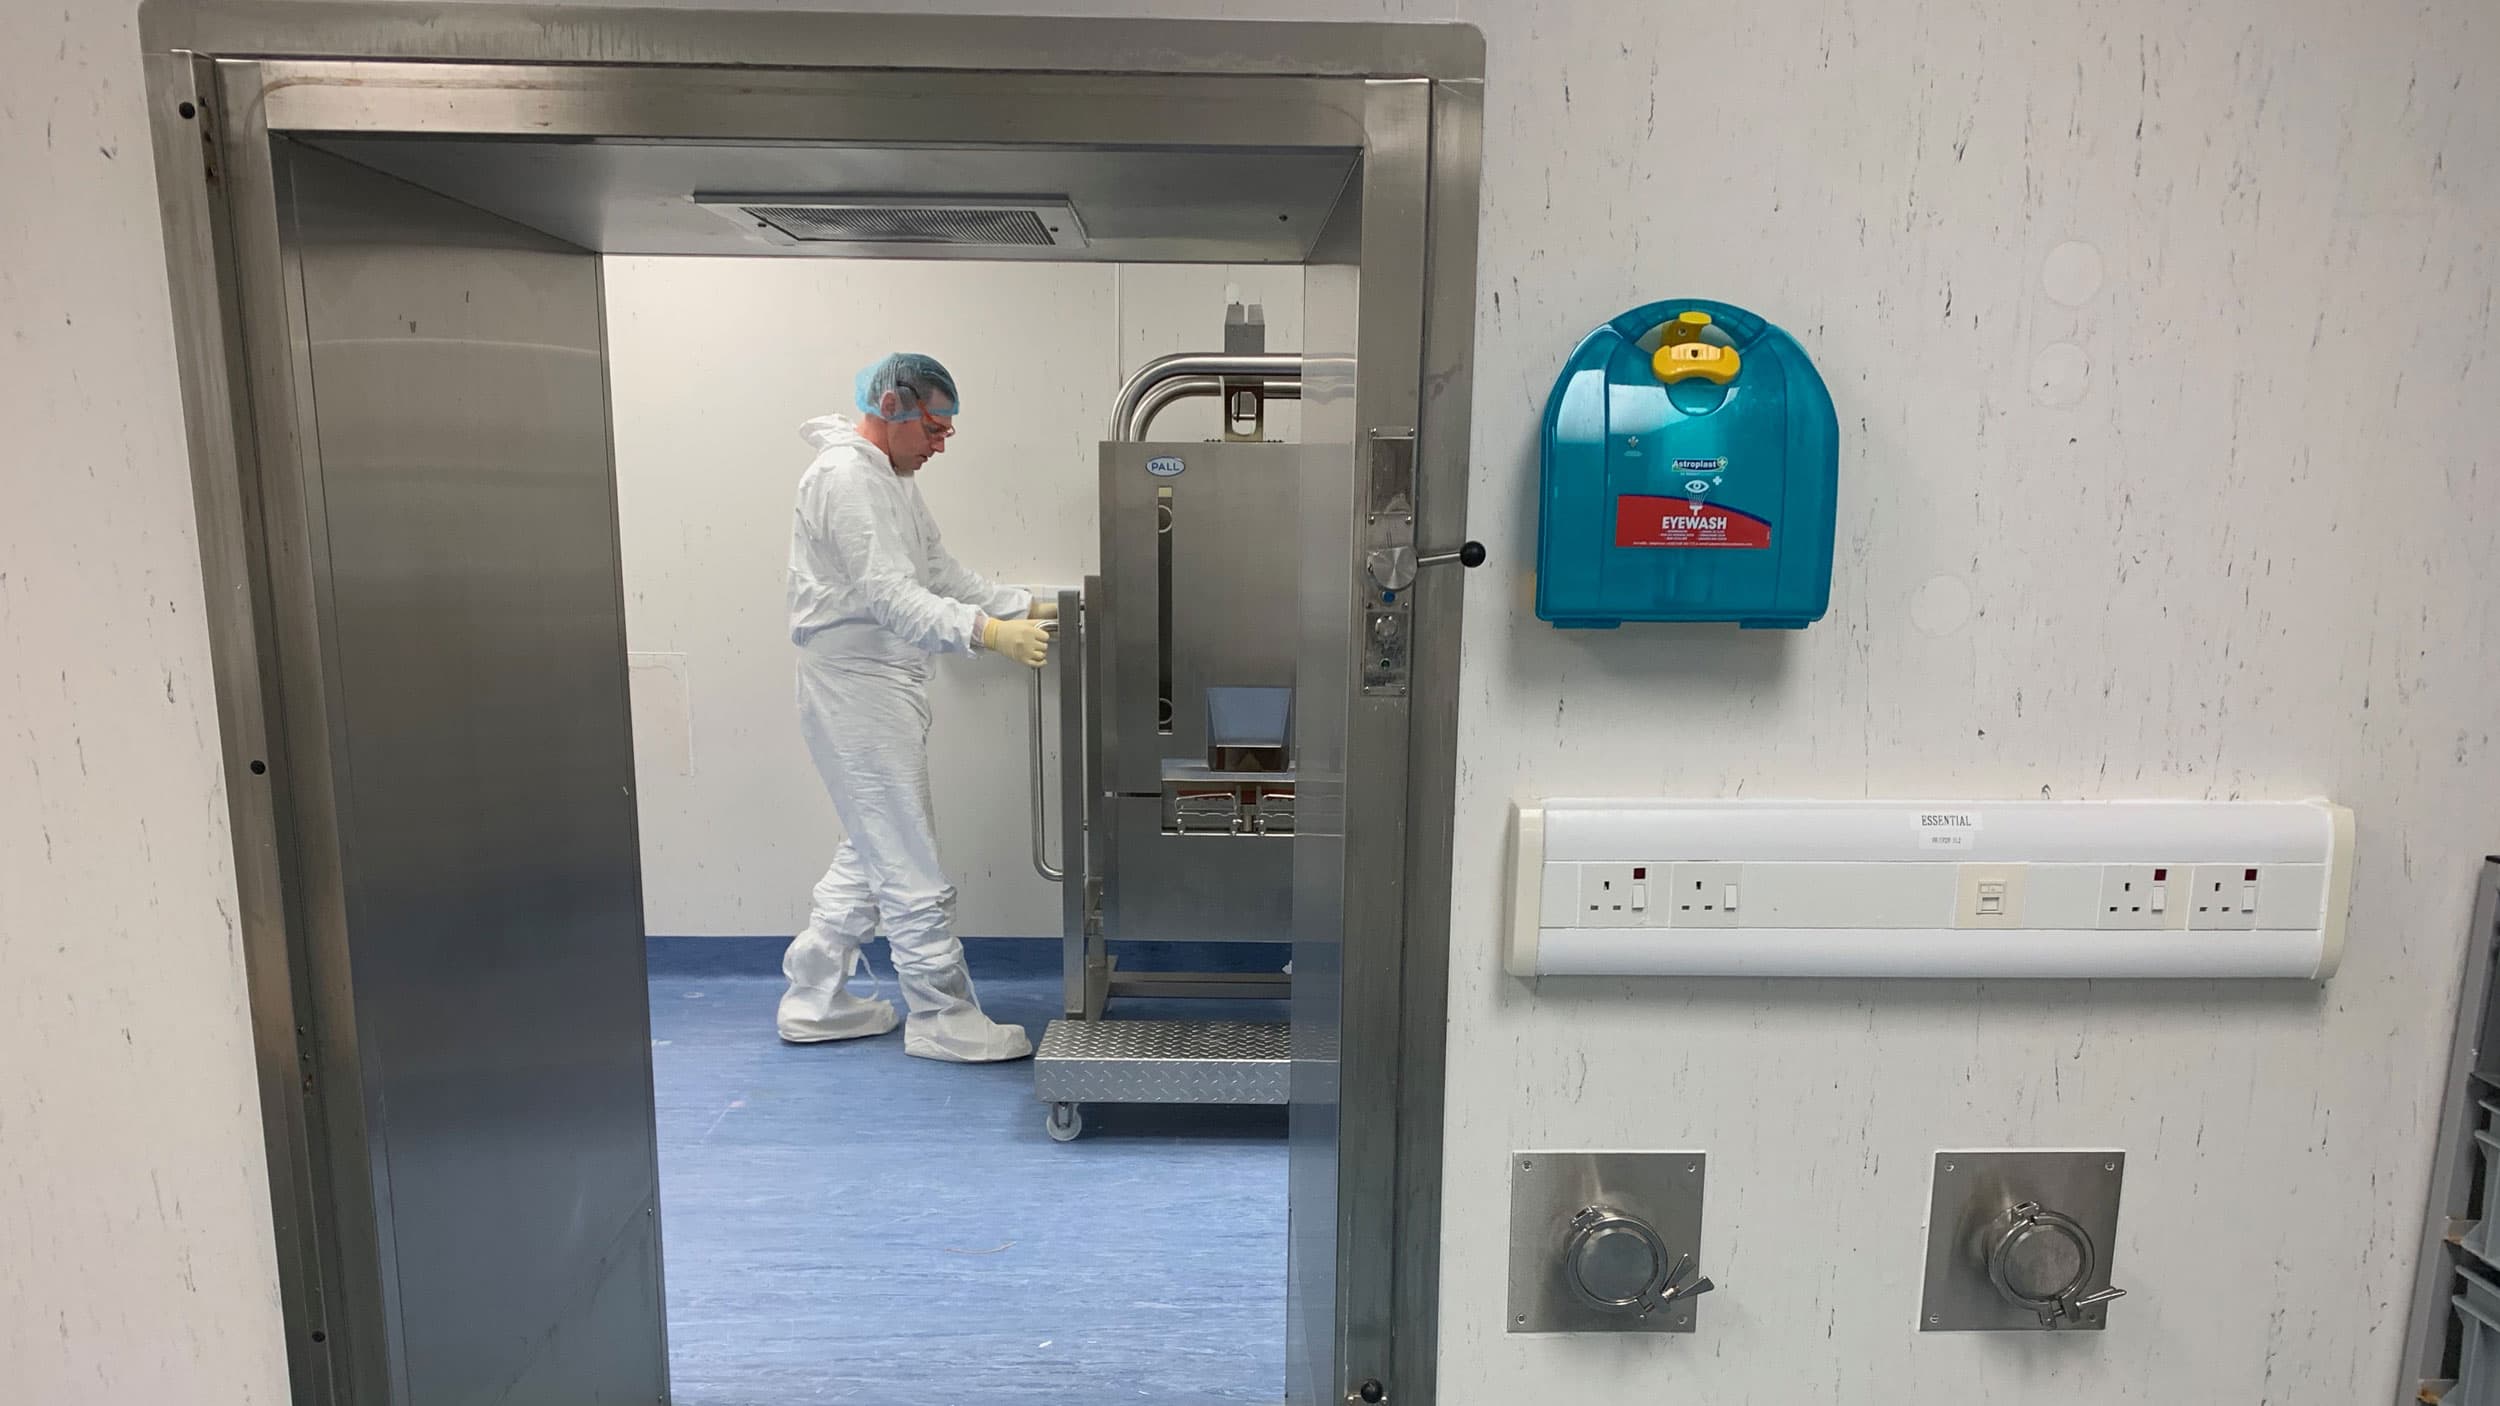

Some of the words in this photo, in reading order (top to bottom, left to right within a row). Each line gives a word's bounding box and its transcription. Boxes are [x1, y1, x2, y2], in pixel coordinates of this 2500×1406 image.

[1151, 462, 1180, 471] PALL
[1673, 459, 1717, 470] Astroplast
[1662, 516, 1728, 530] EYEWASH
[1921, 815, 1972, 826] ESSENTIAL
